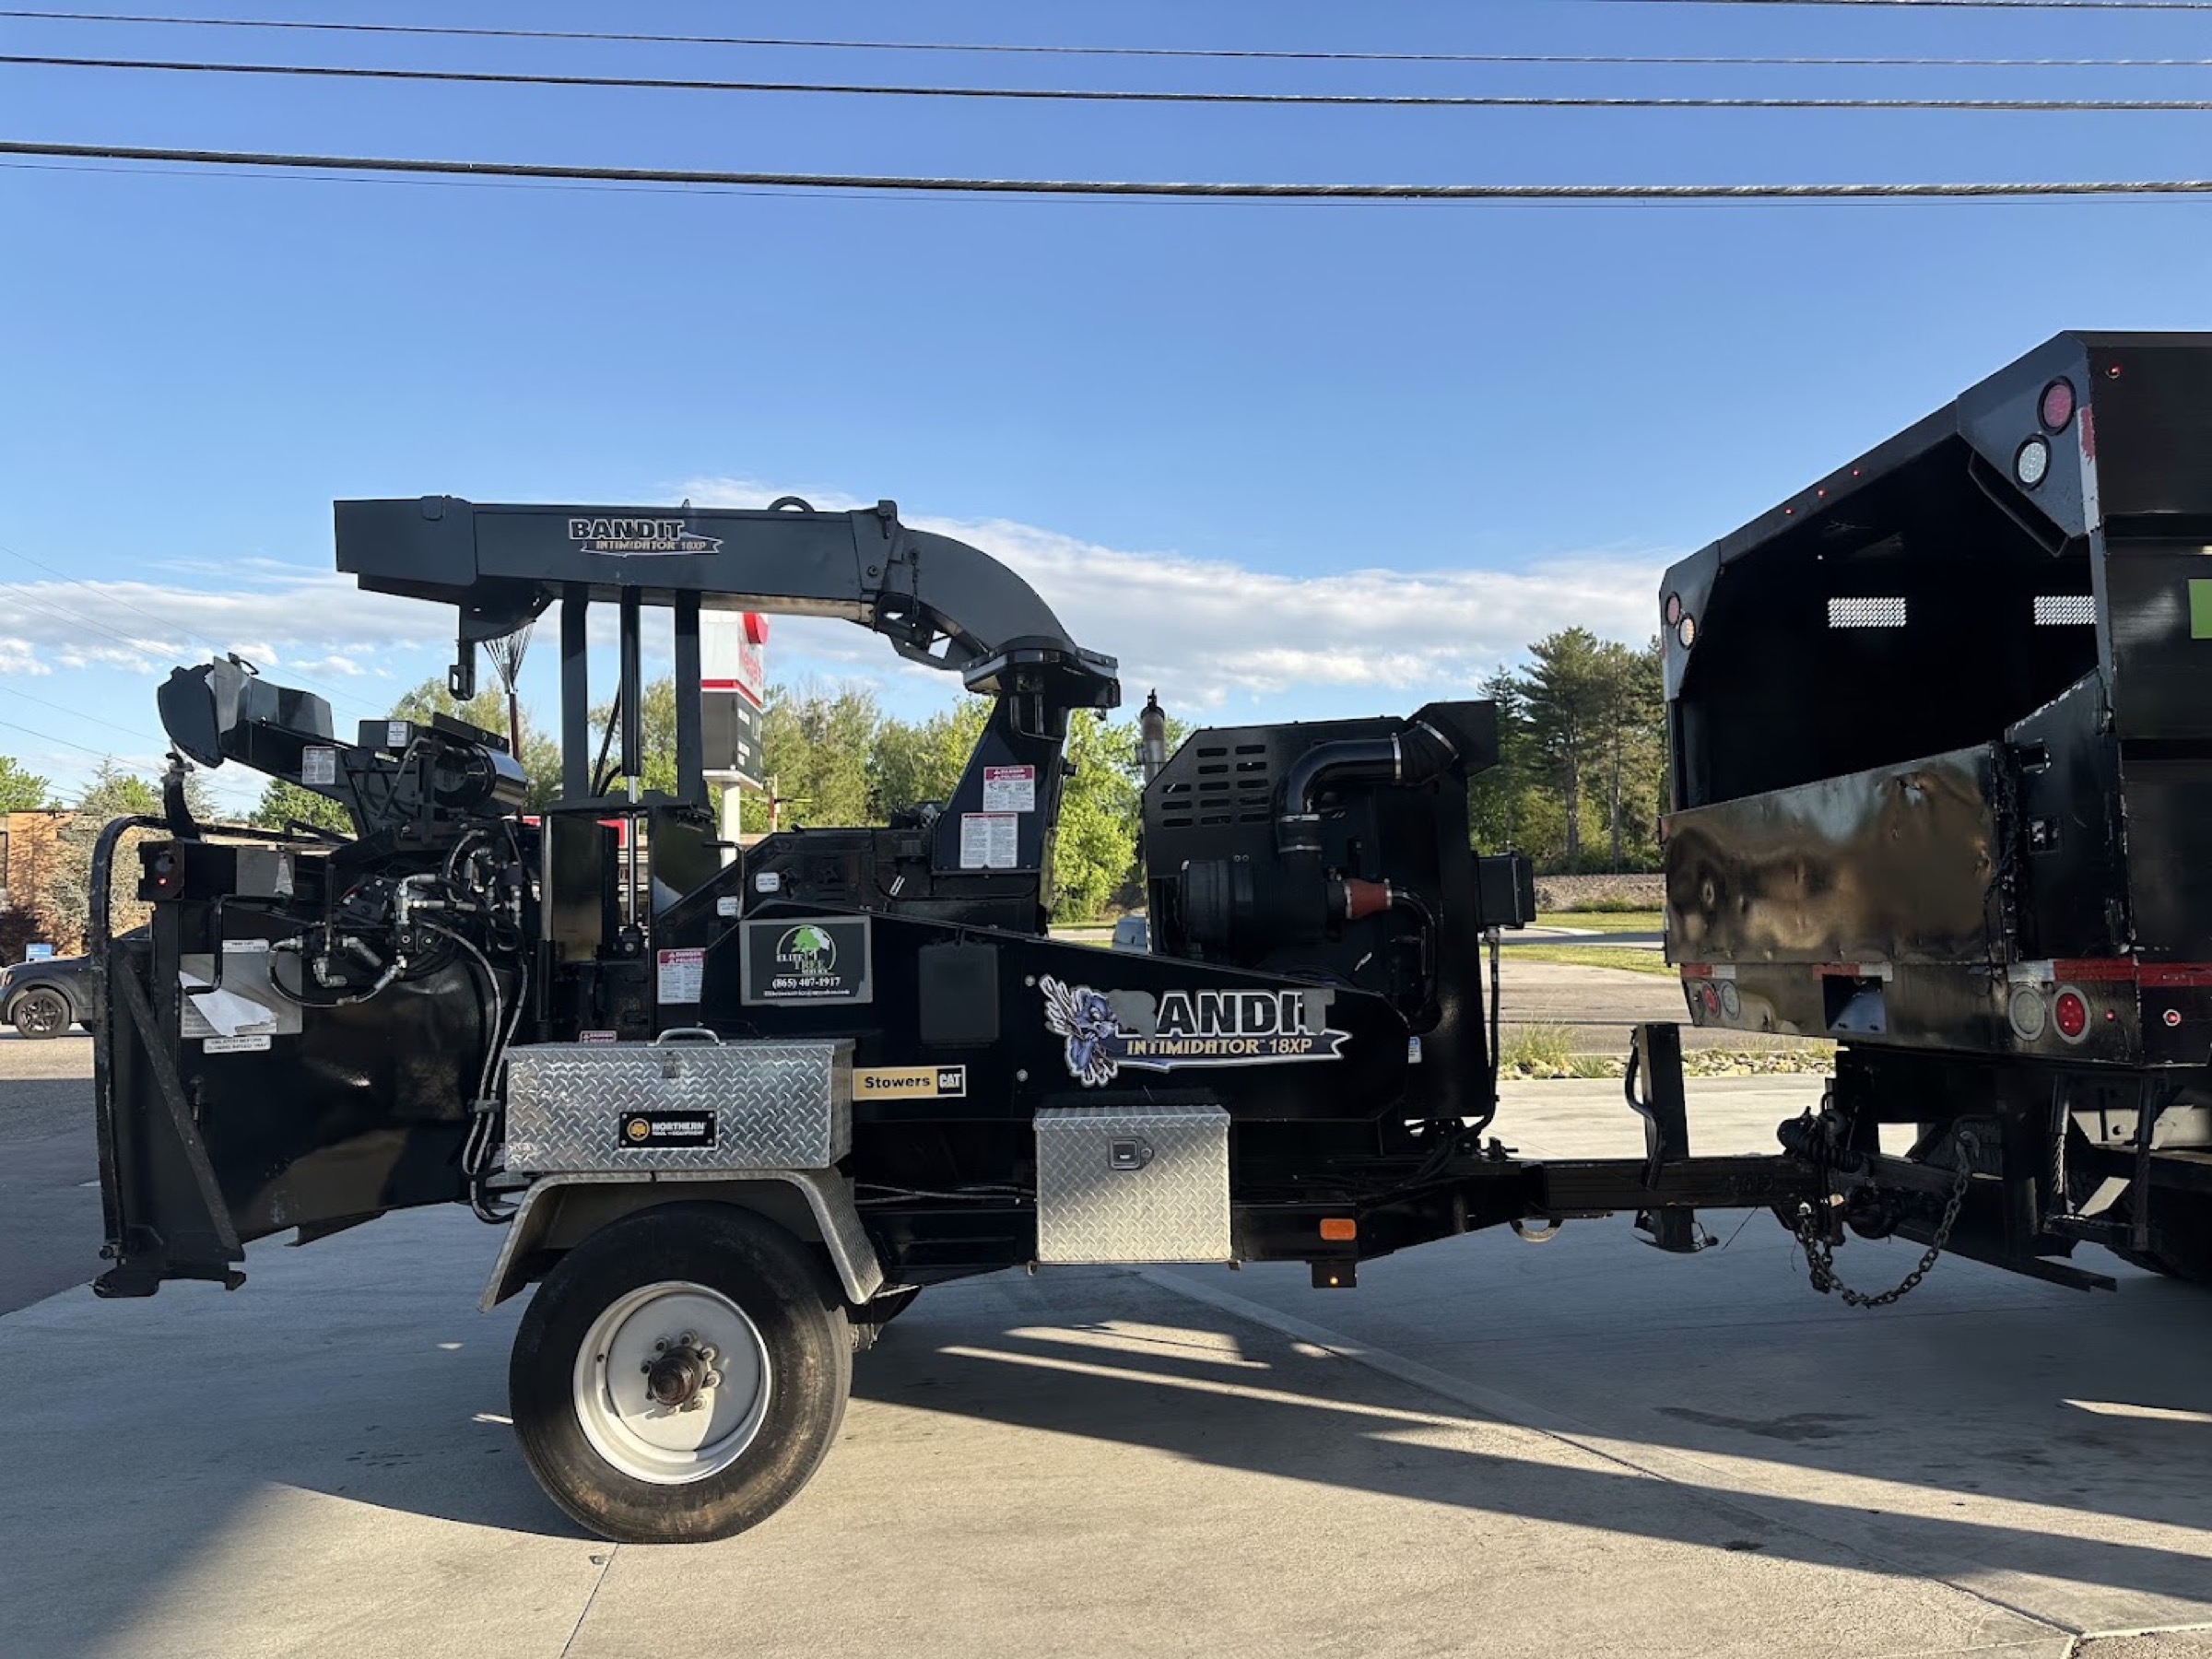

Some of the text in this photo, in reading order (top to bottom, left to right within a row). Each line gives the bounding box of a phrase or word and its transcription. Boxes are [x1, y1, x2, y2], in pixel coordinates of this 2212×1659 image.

[569, 519, 685, 540] BANDIT
[776, 954, 803, 962] ELITE
[1269, 1038, 1312, 1054] 18XP
[864, 1073, 962, 1088] Stowers CAT
